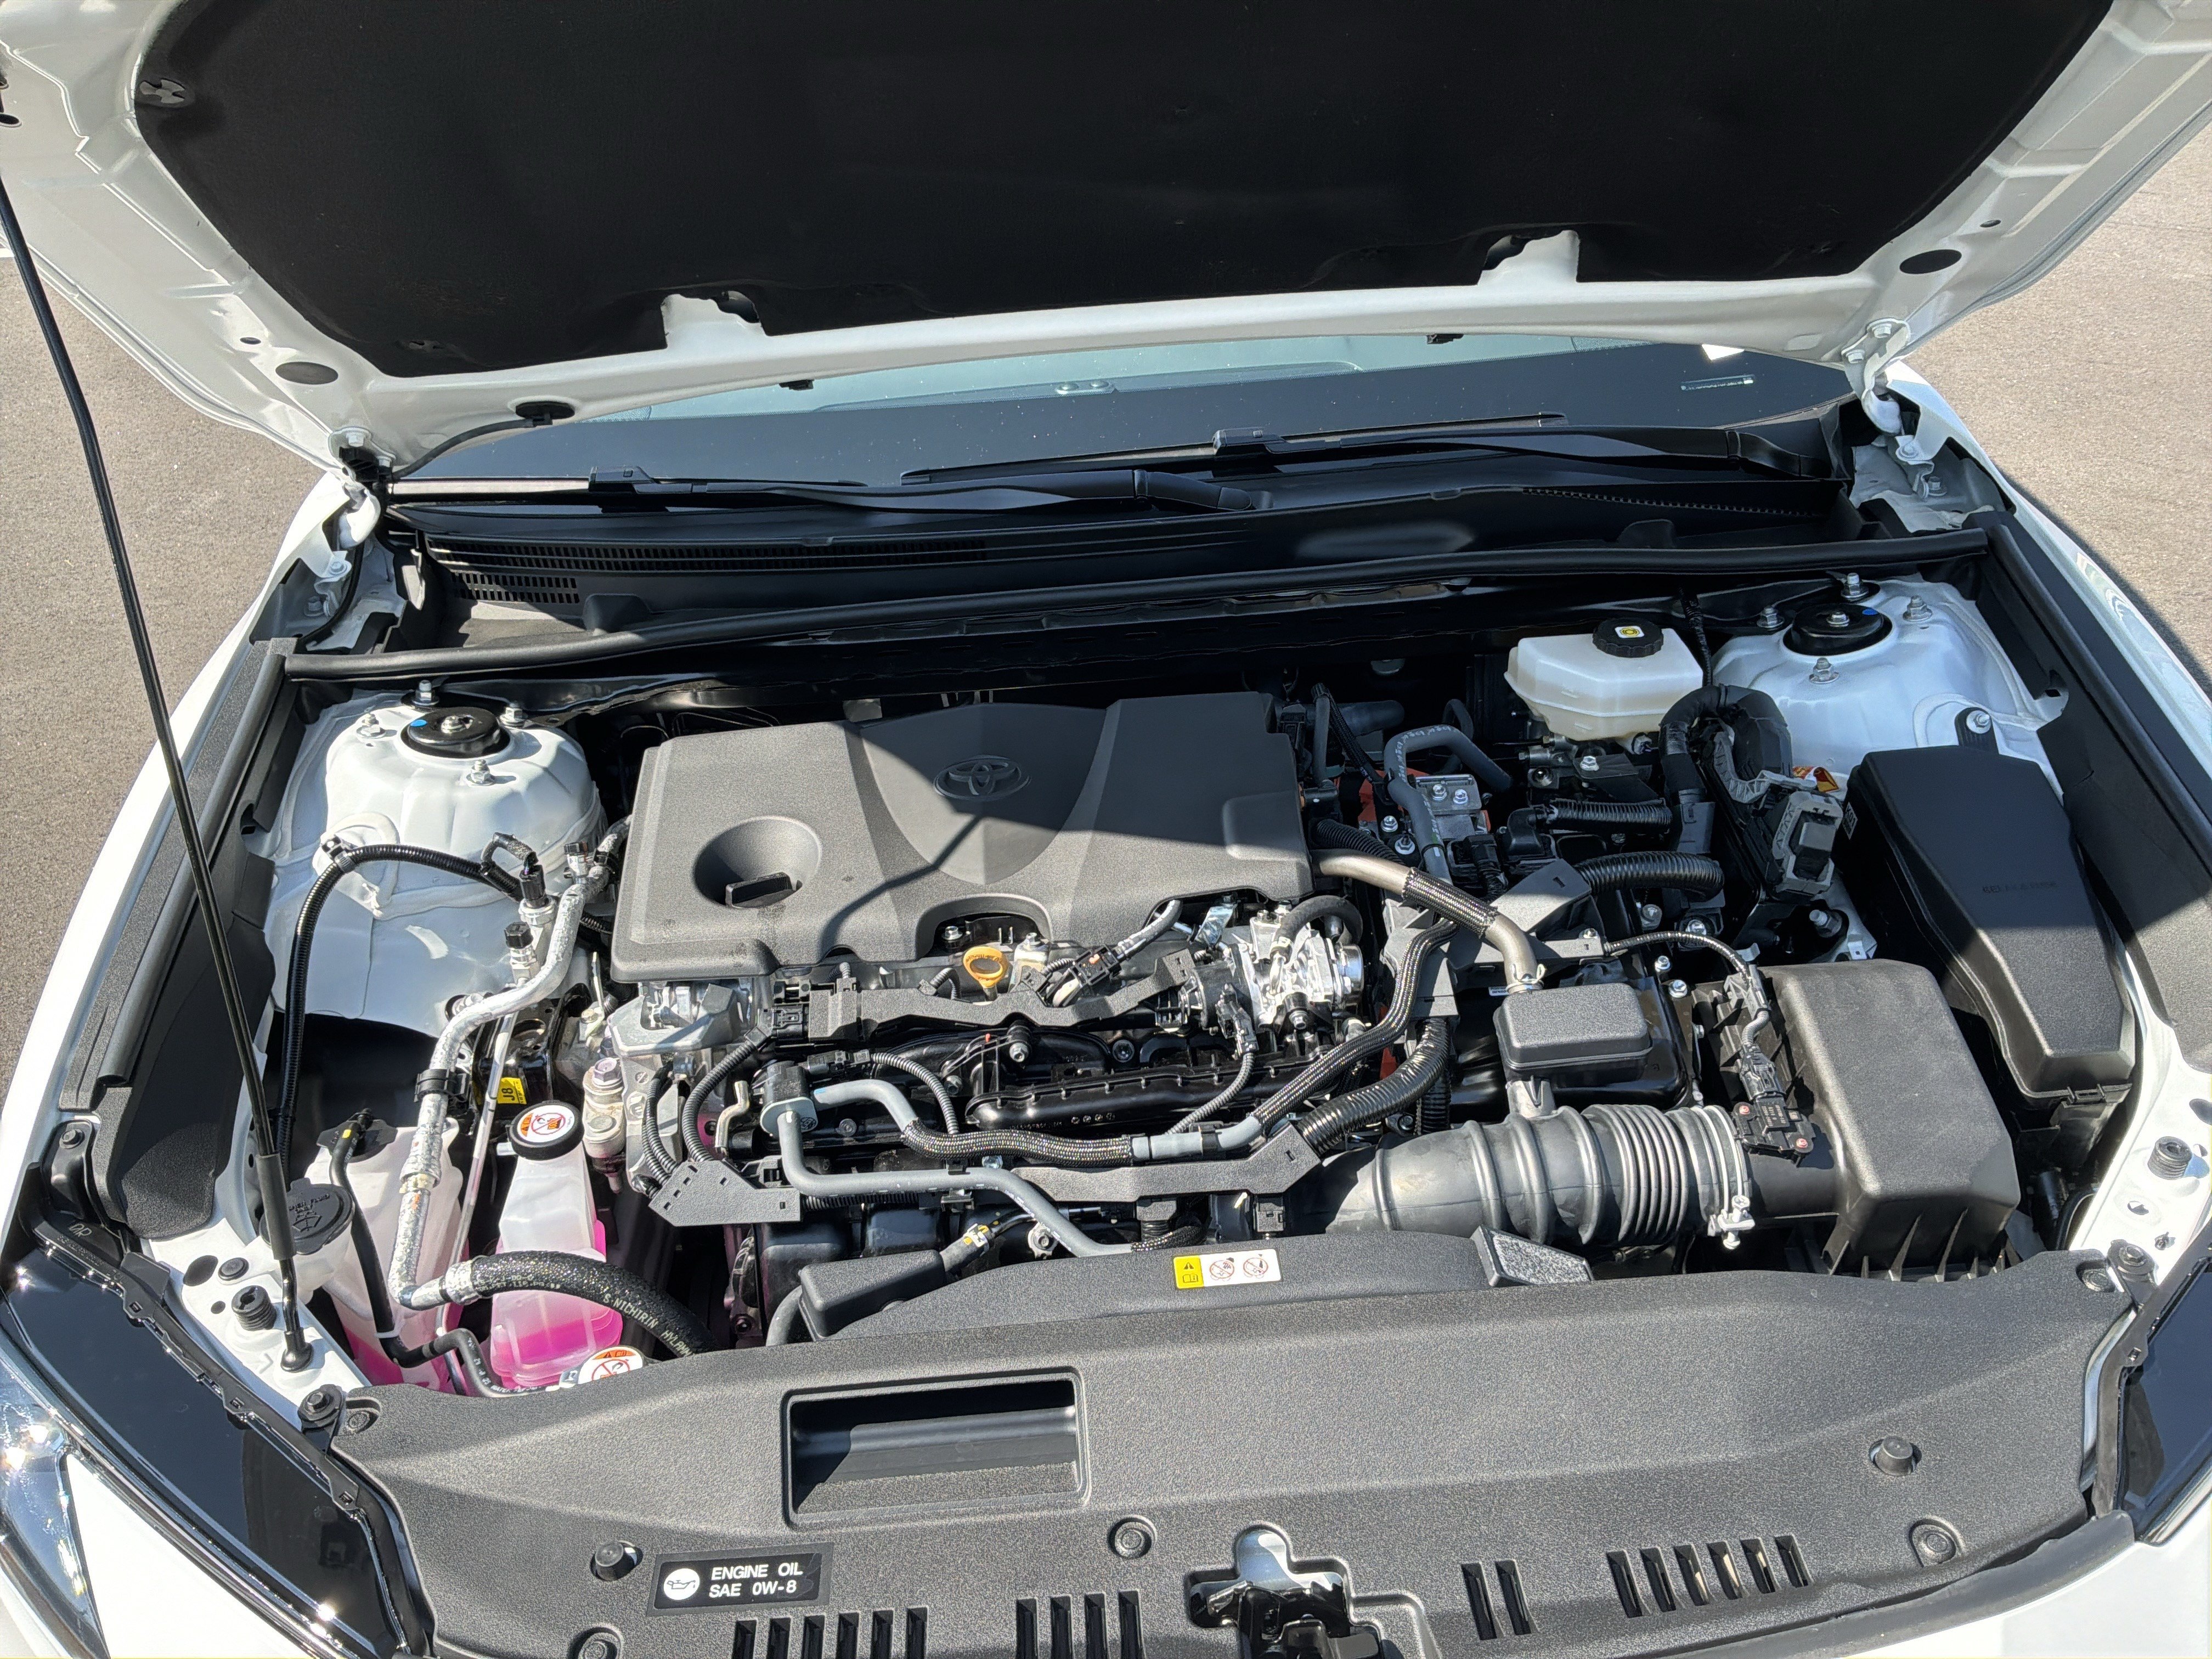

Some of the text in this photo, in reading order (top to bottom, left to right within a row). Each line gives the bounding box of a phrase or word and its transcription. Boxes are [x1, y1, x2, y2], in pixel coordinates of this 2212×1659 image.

[501, 1087, 515, 1101] J8
[711, 1562, 803, 1581] ENGINE OIL
[709, 1579, 797, 1598] SAE 0W-8
